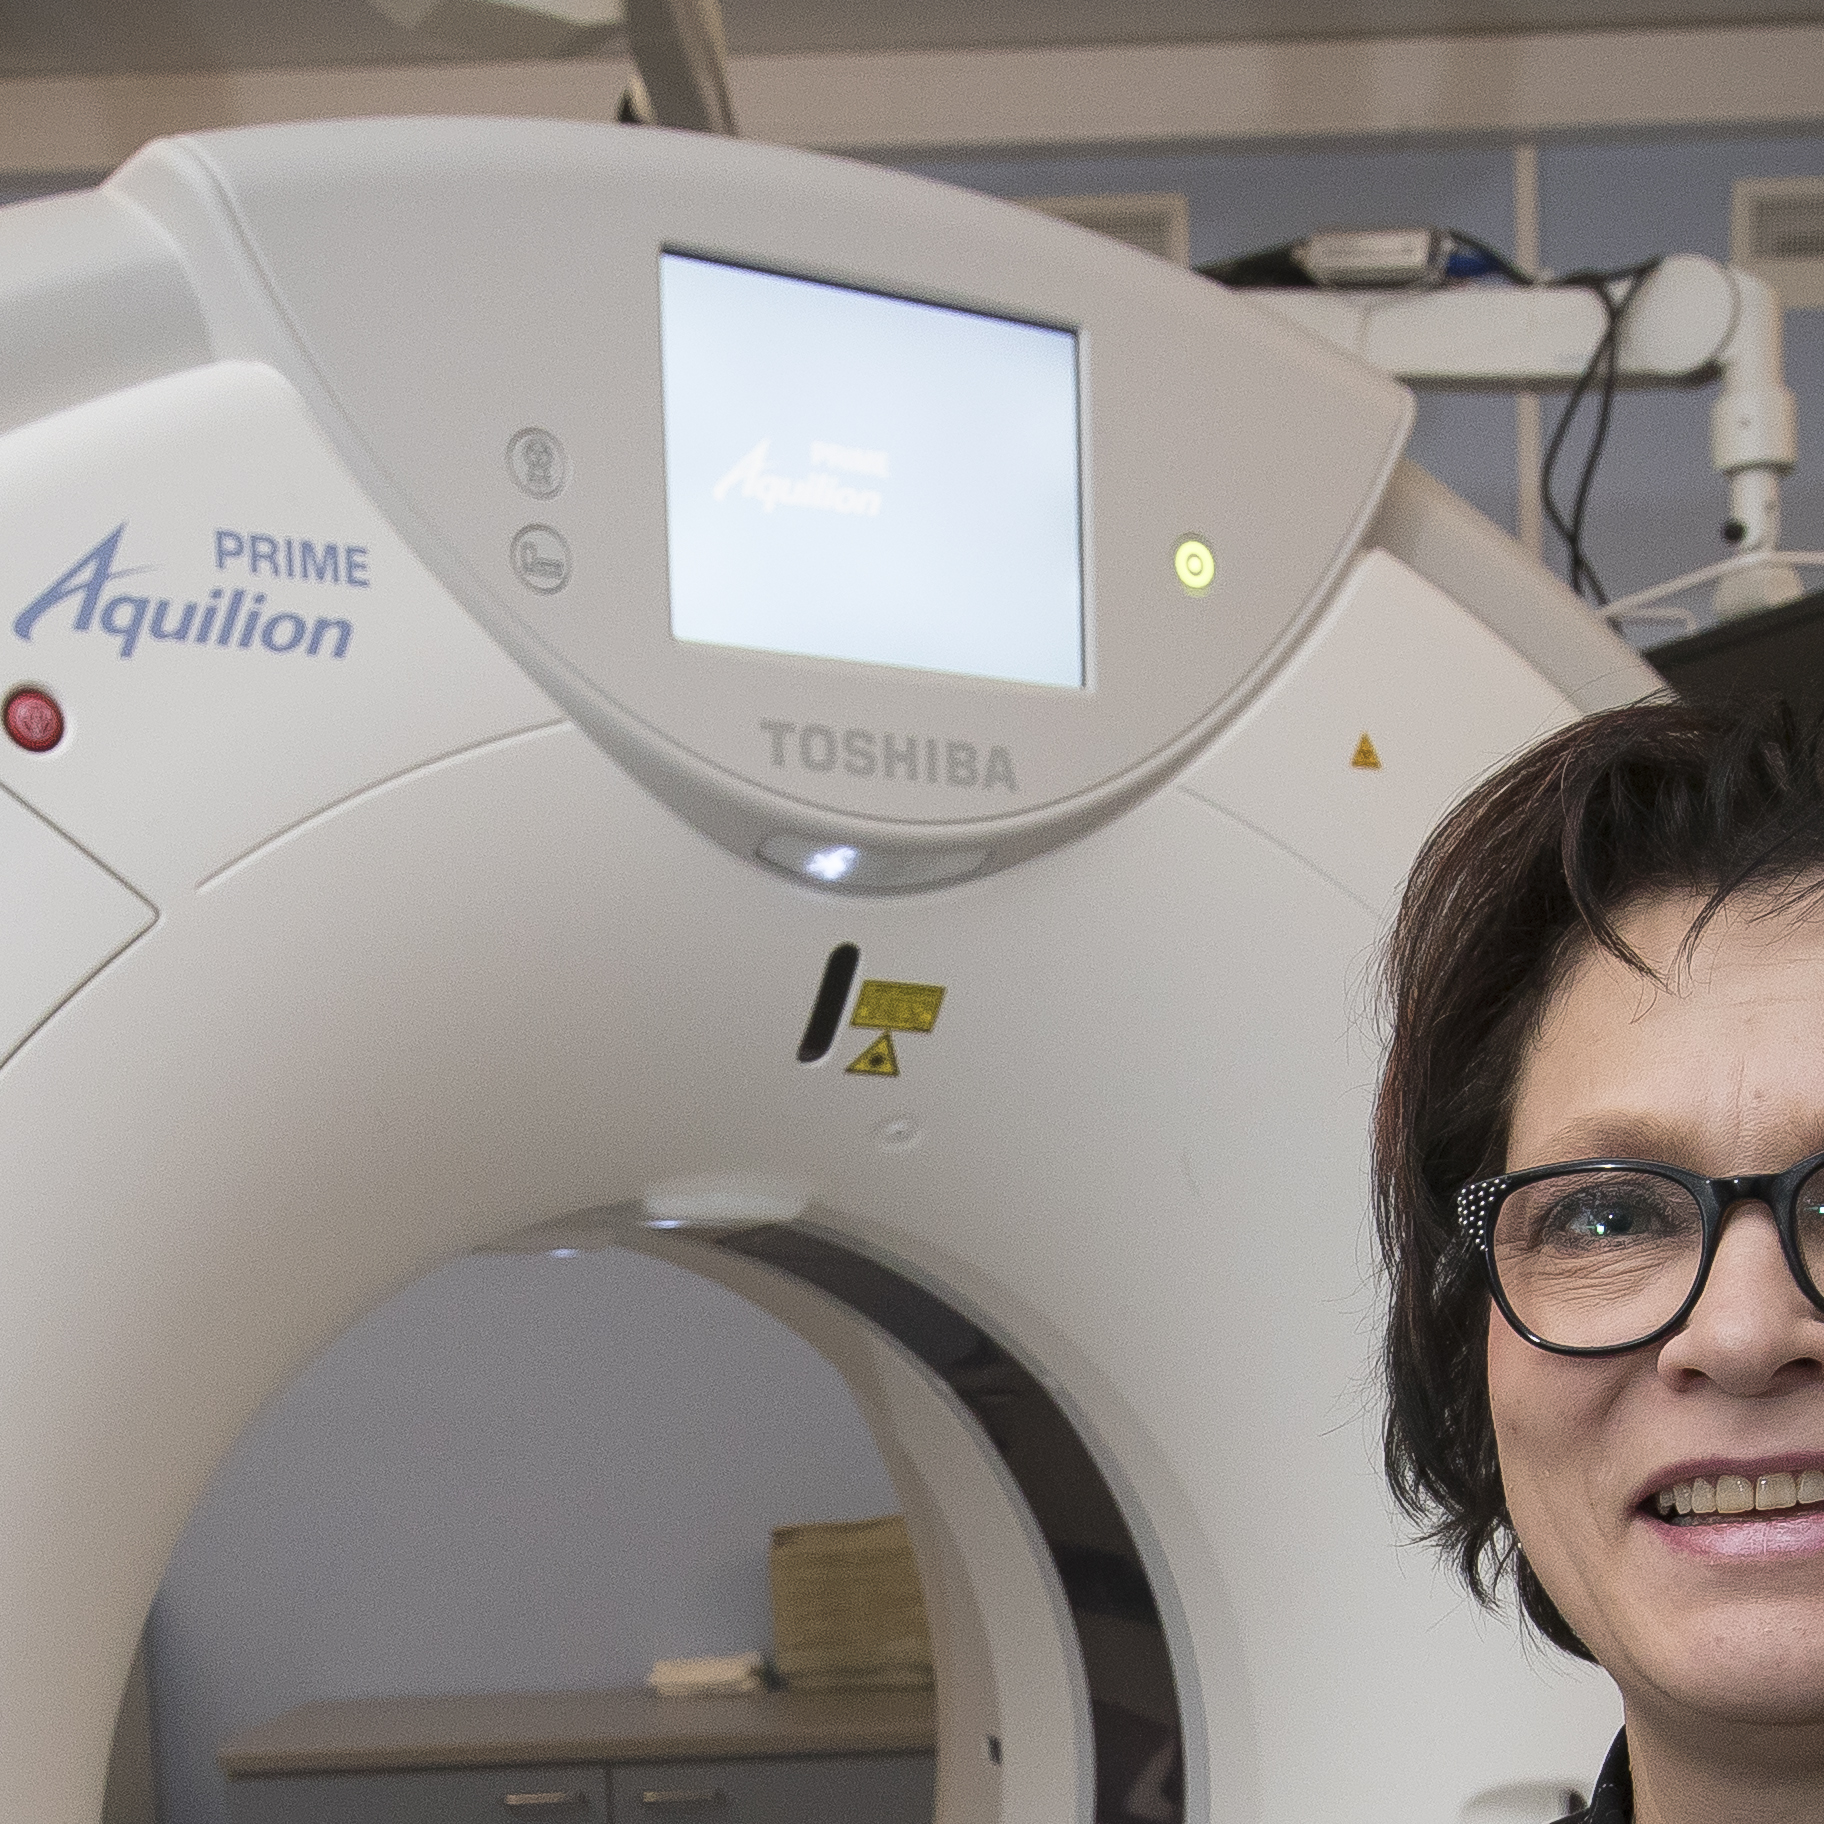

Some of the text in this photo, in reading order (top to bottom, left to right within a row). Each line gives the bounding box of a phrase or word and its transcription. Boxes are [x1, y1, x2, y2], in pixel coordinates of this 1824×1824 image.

[713, 437, 881, 517] Aquilion
[13, 522, 354, 657] Aquilion
[214, 528, 372, 588] PRIME
[760, 716, 1019, 792] TOSHIBA
